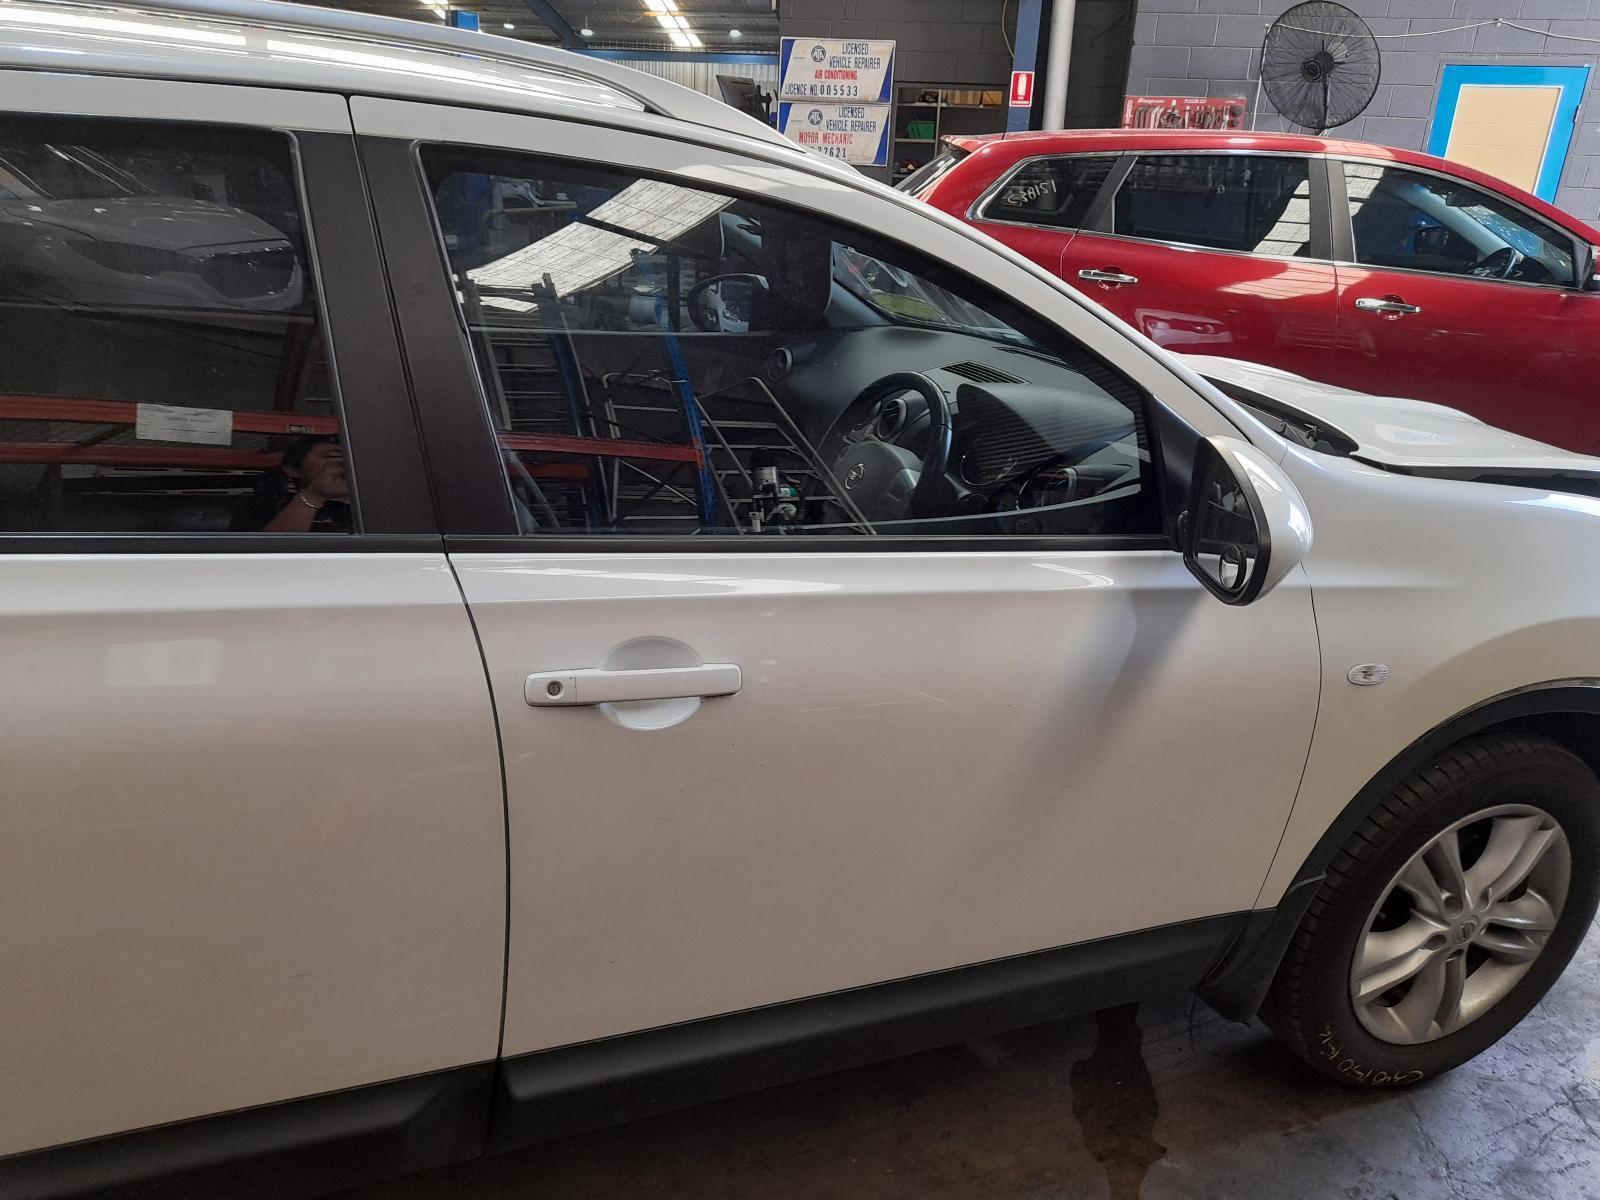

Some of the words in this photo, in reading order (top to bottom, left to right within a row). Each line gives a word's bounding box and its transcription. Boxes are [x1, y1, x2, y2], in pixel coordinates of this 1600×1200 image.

[842, 42, 869, 55] LICENSED
[829, 56, 852, 69] VEHICLE
[854, 57, 881, 70] REPAIRER
[815, 69, 823, 80] AIR
[824, 70, 858, 80] CONDITIONING
[785, 83, 807, 96] LICENCE
[820, 84, 858, 97] 005533
[838, 106, 865, 119] LICENSED
[826, 120, 848, 132] VEHICLE
[850, 121, 877, 133] REPAIRER
[798, 131, 819, 144] MOTOR
[822, 132, 854, 145] MECHANIC
